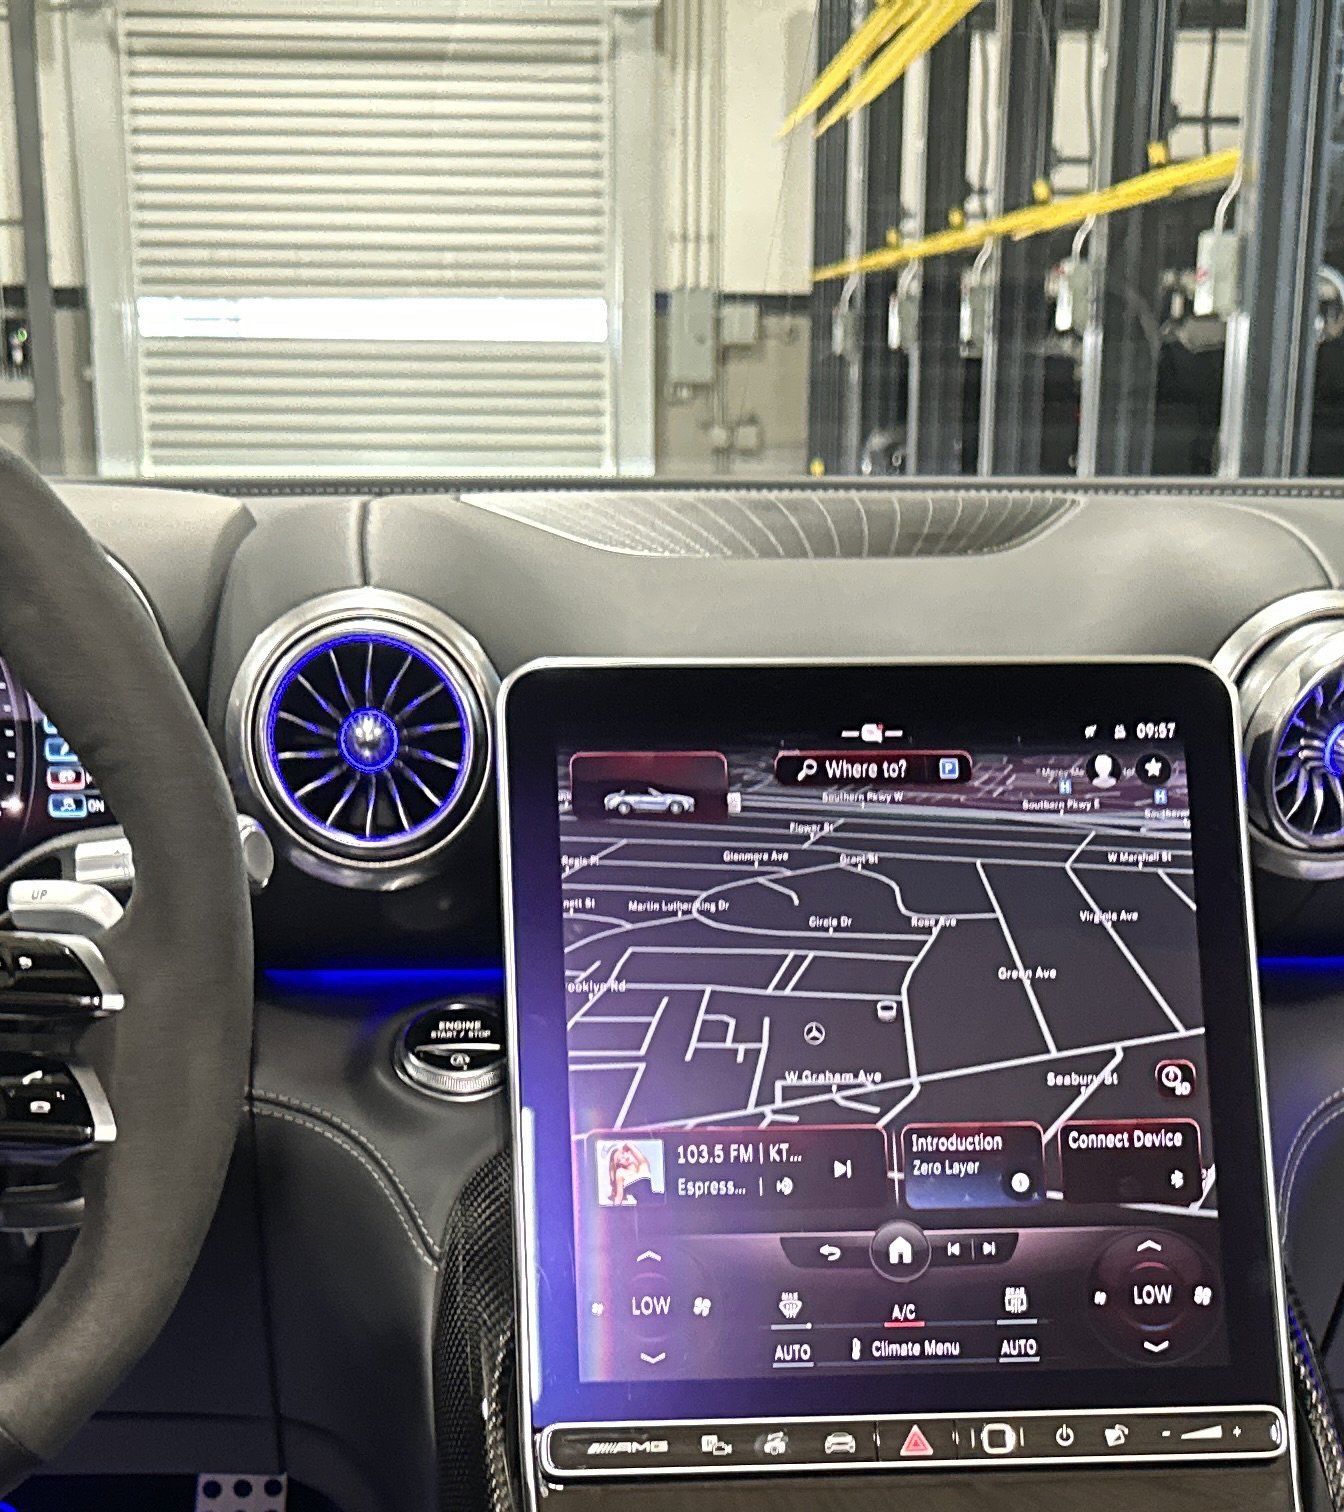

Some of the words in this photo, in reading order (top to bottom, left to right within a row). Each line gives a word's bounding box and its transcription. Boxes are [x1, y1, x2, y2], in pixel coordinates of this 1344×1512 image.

[1136, 721, 1176, 740] 09:57
[825, 758, 878, 780] Where
[882, 758, 907, 780] to?
[88, 799, 105, 813] ON
[771, 849, 789, 862] Ave
[31, 889, 48, 900] UP
[628, 900, 659, 912] Martin
[662, 900, 693, 913] Luther
[695, 900, 716, 913] King
[719, 900, 729, 911] Dr
[840, 915, 853, 927] Dr
[1120, 909, 1139, 922] Ave
[997, 967, 1032, 980] Green
[1036, 966, 1057, 980] Ave
[430, 1029, 456, 1039] START
[468, 1029, 491, 1039] STOP
[438, 1020, 482, 1031] ENGINE
[785, 1070, 799, 1084] W
[802, 1069, 854, 1085] Graham
[857, 1069, 882, 1084] Ave
[1047, 1071, 1098, 1088] Seabury
[911, 1132, 1003, 1152] Introduction
[1068, 1130, 1130, 1149] Connect
[1133, 1129, 1183, 1149] Device
[677, 1144, 724, 1164] 103.5
[730, 1143, 754, 1164] FM
[912, 1158, 941, 1176] Zero
[945, 1158, 980, 1178] Layer
[1133, 1284, 1172, 1305] LOW
[631, 1295, 671, 1316] LOW
[892, 1303, 916, 1320] A/C
[774, 1343, 811, 1361] AUTO
[872, 1340, 921, 1357] Climate
[924, 1339, 960, 1356] Menu
[1001, 1338, 1037, 1356] AUTO
